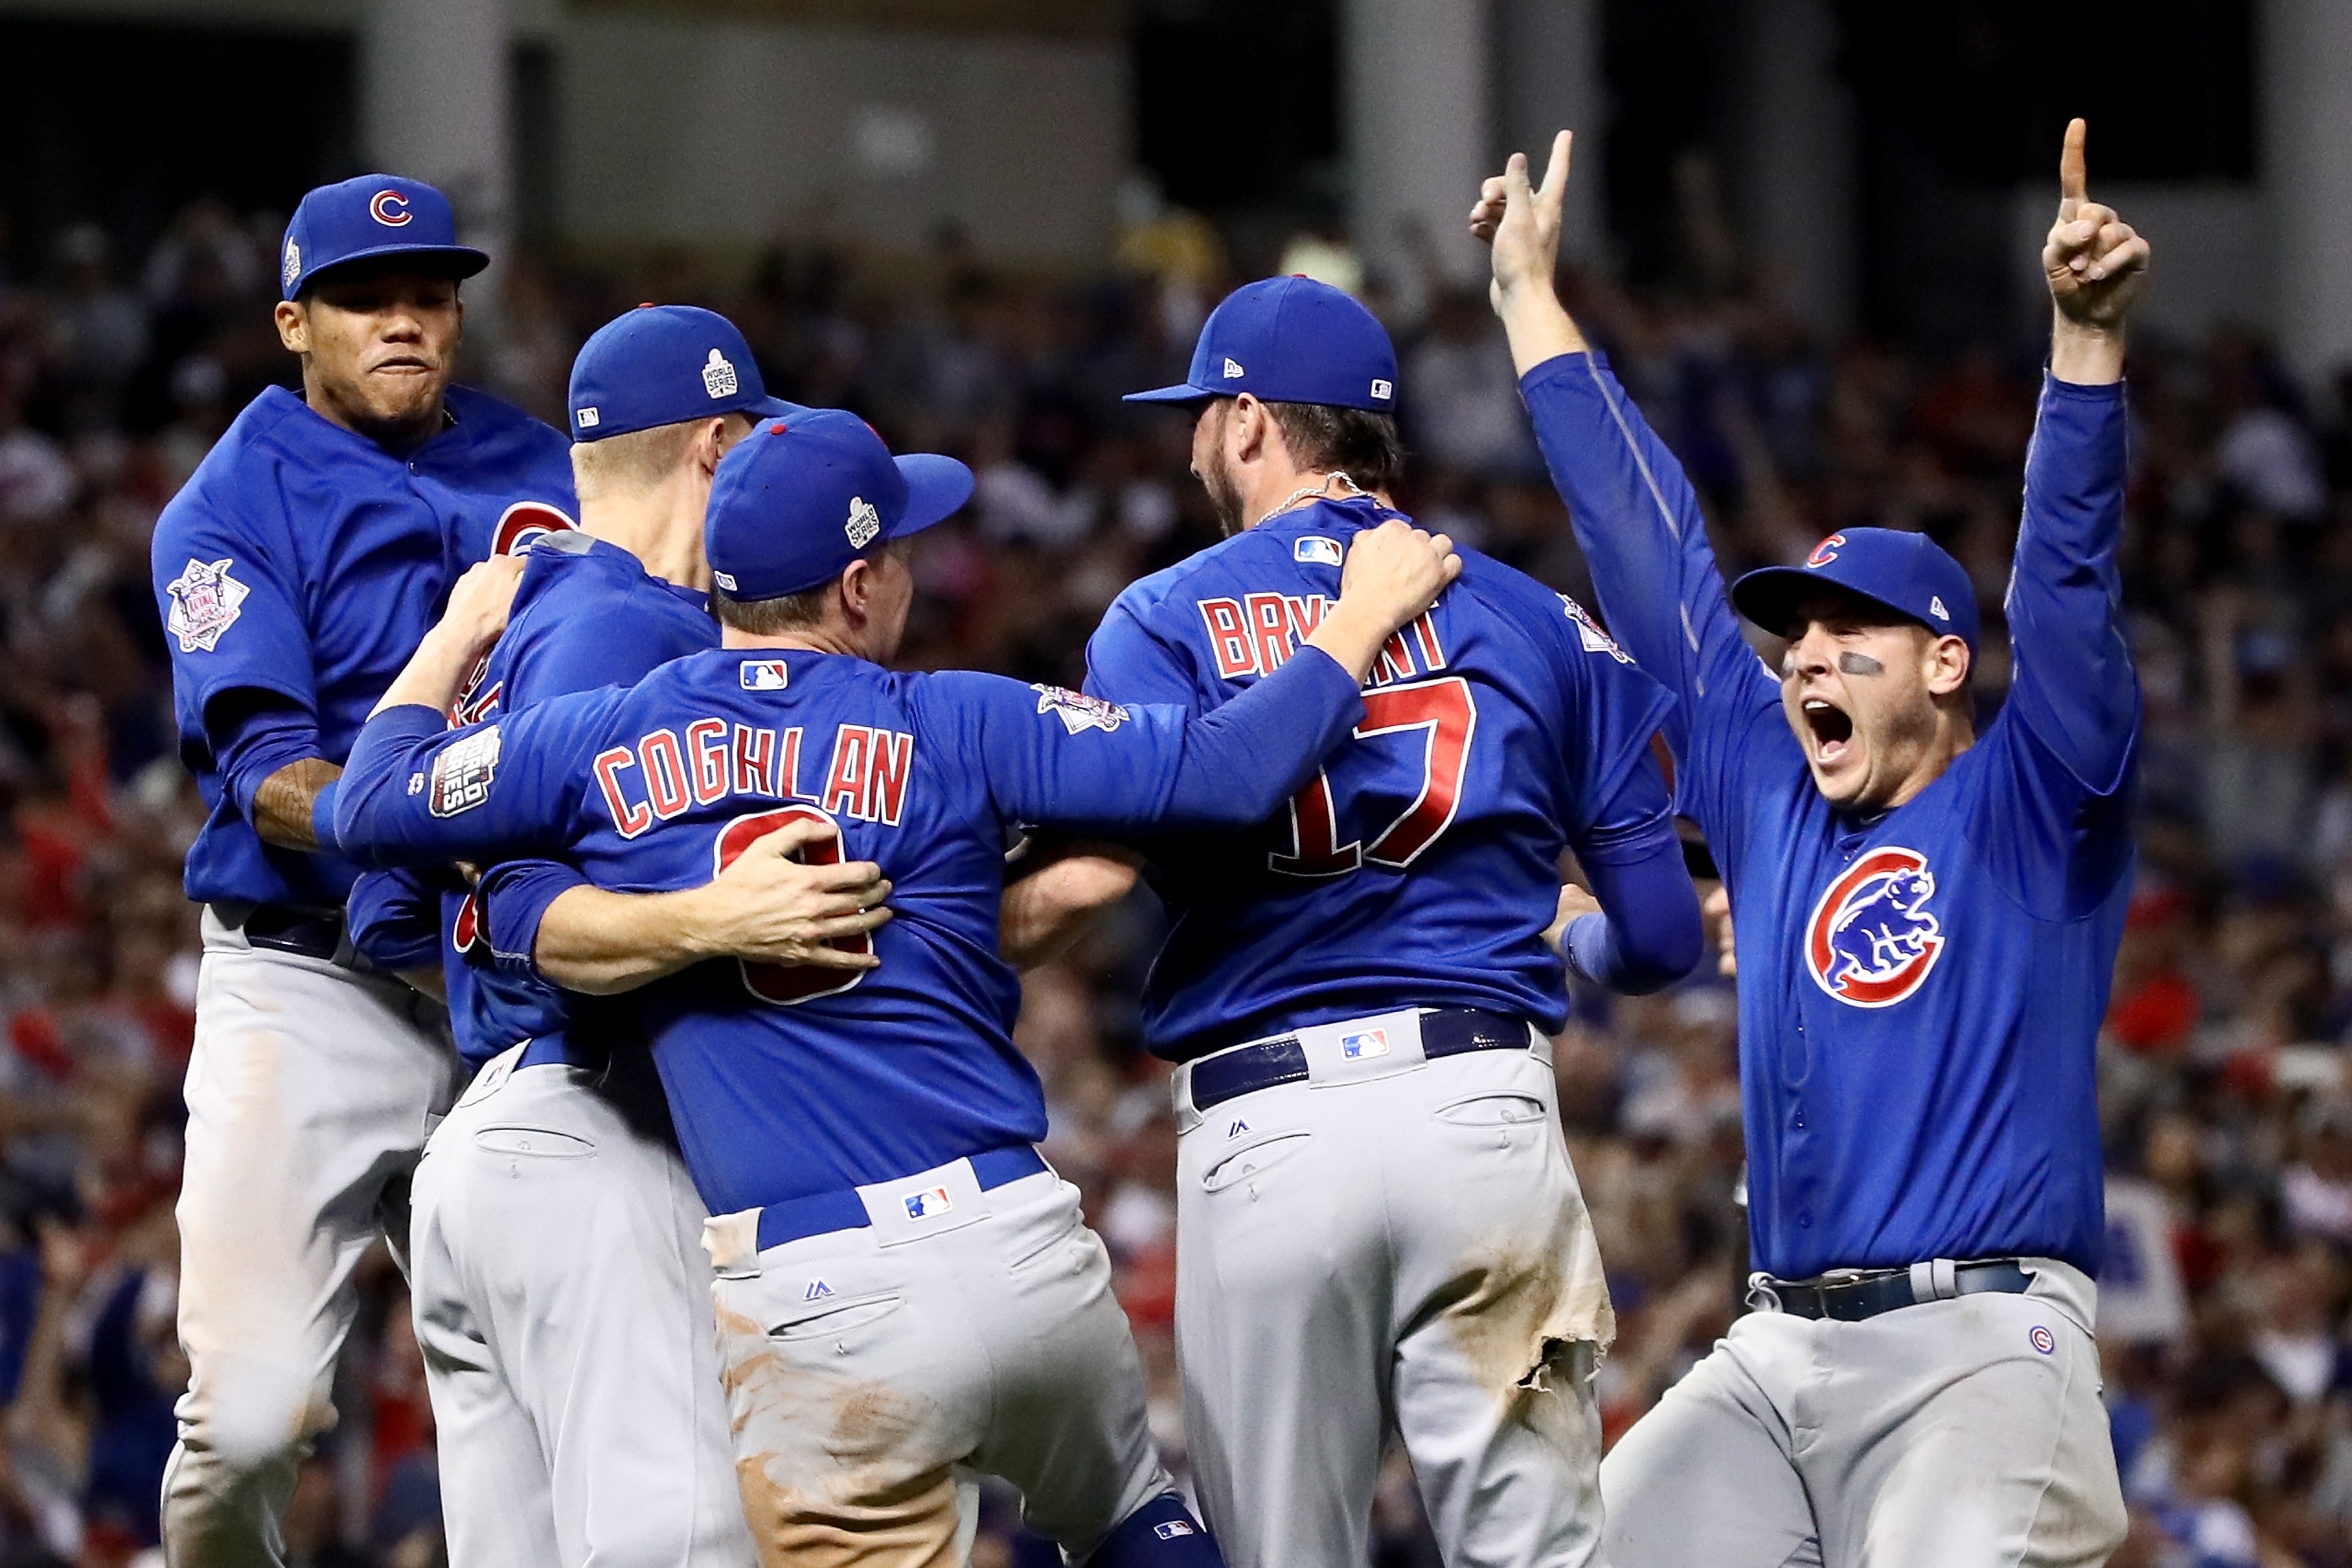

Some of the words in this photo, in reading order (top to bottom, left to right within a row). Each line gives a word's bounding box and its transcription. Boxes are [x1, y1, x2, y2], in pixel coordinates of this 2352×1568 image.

[369, 189, 413, 227] C
[705, 366, 733, 379] WORLD
[708, 376, 735, 391] SERIES
[848, 507, 873, 533] WORLD
[851, 515, 878, 544] SERIES
[1806, 534, 1846, 568] C
[1197, 591, 1447, 688] BRYNT
[593, 717, 914, 840] COGHLAN
[1268, 676, 1477, 877] 17
